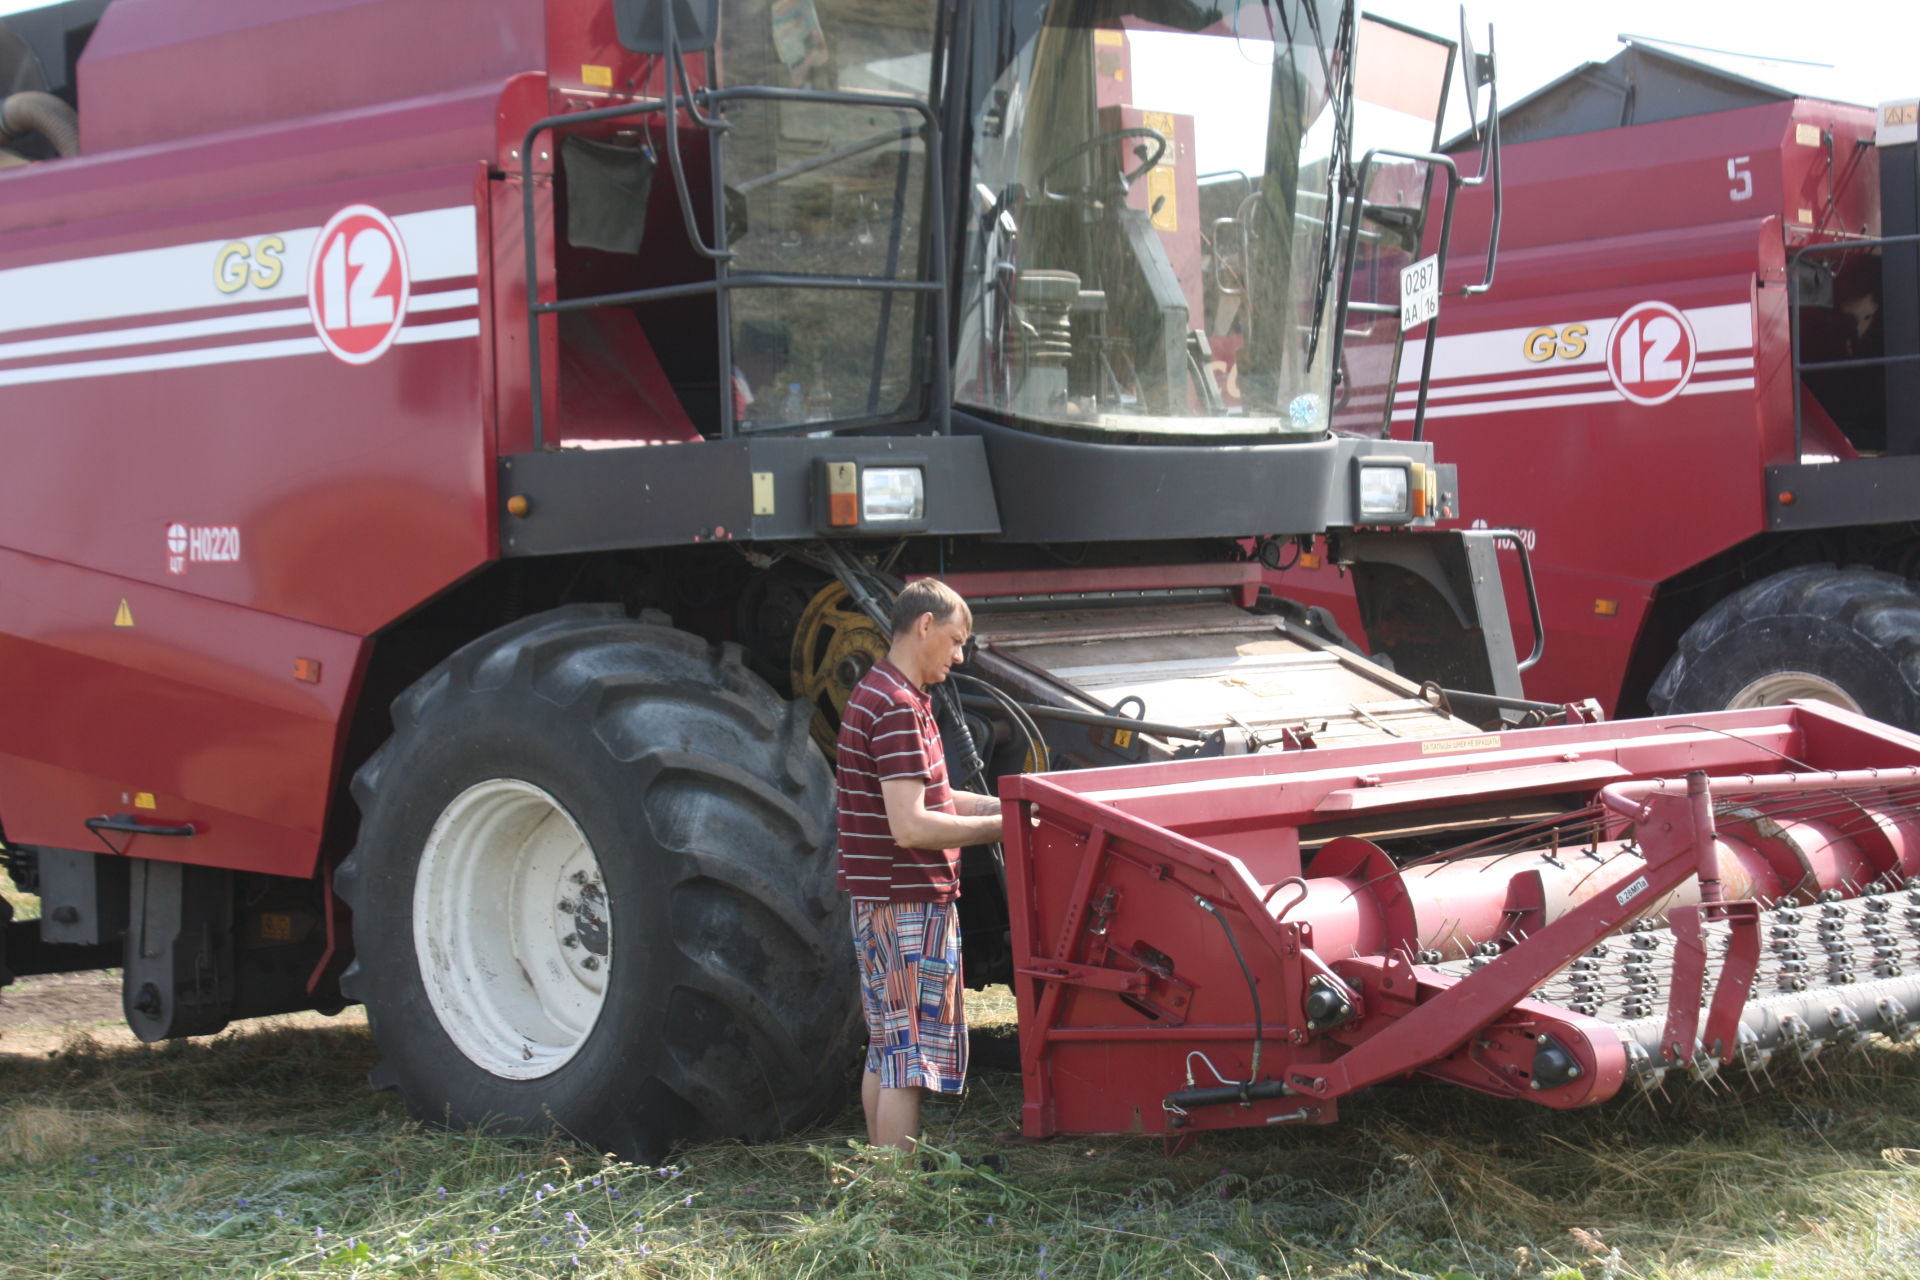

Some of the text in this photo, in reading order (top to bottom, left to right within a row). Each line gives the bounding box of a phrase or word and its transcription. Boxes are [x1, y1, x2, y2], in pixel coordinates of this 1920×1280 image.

[1727, 156, 1753, 201] 5
[214, 228, 395, 330] GS 12
[1405, 263, 1434, 297] 0287
[1425, 295, 1436, 314] 16
[1523, 316, 1682, 384] GS 12
